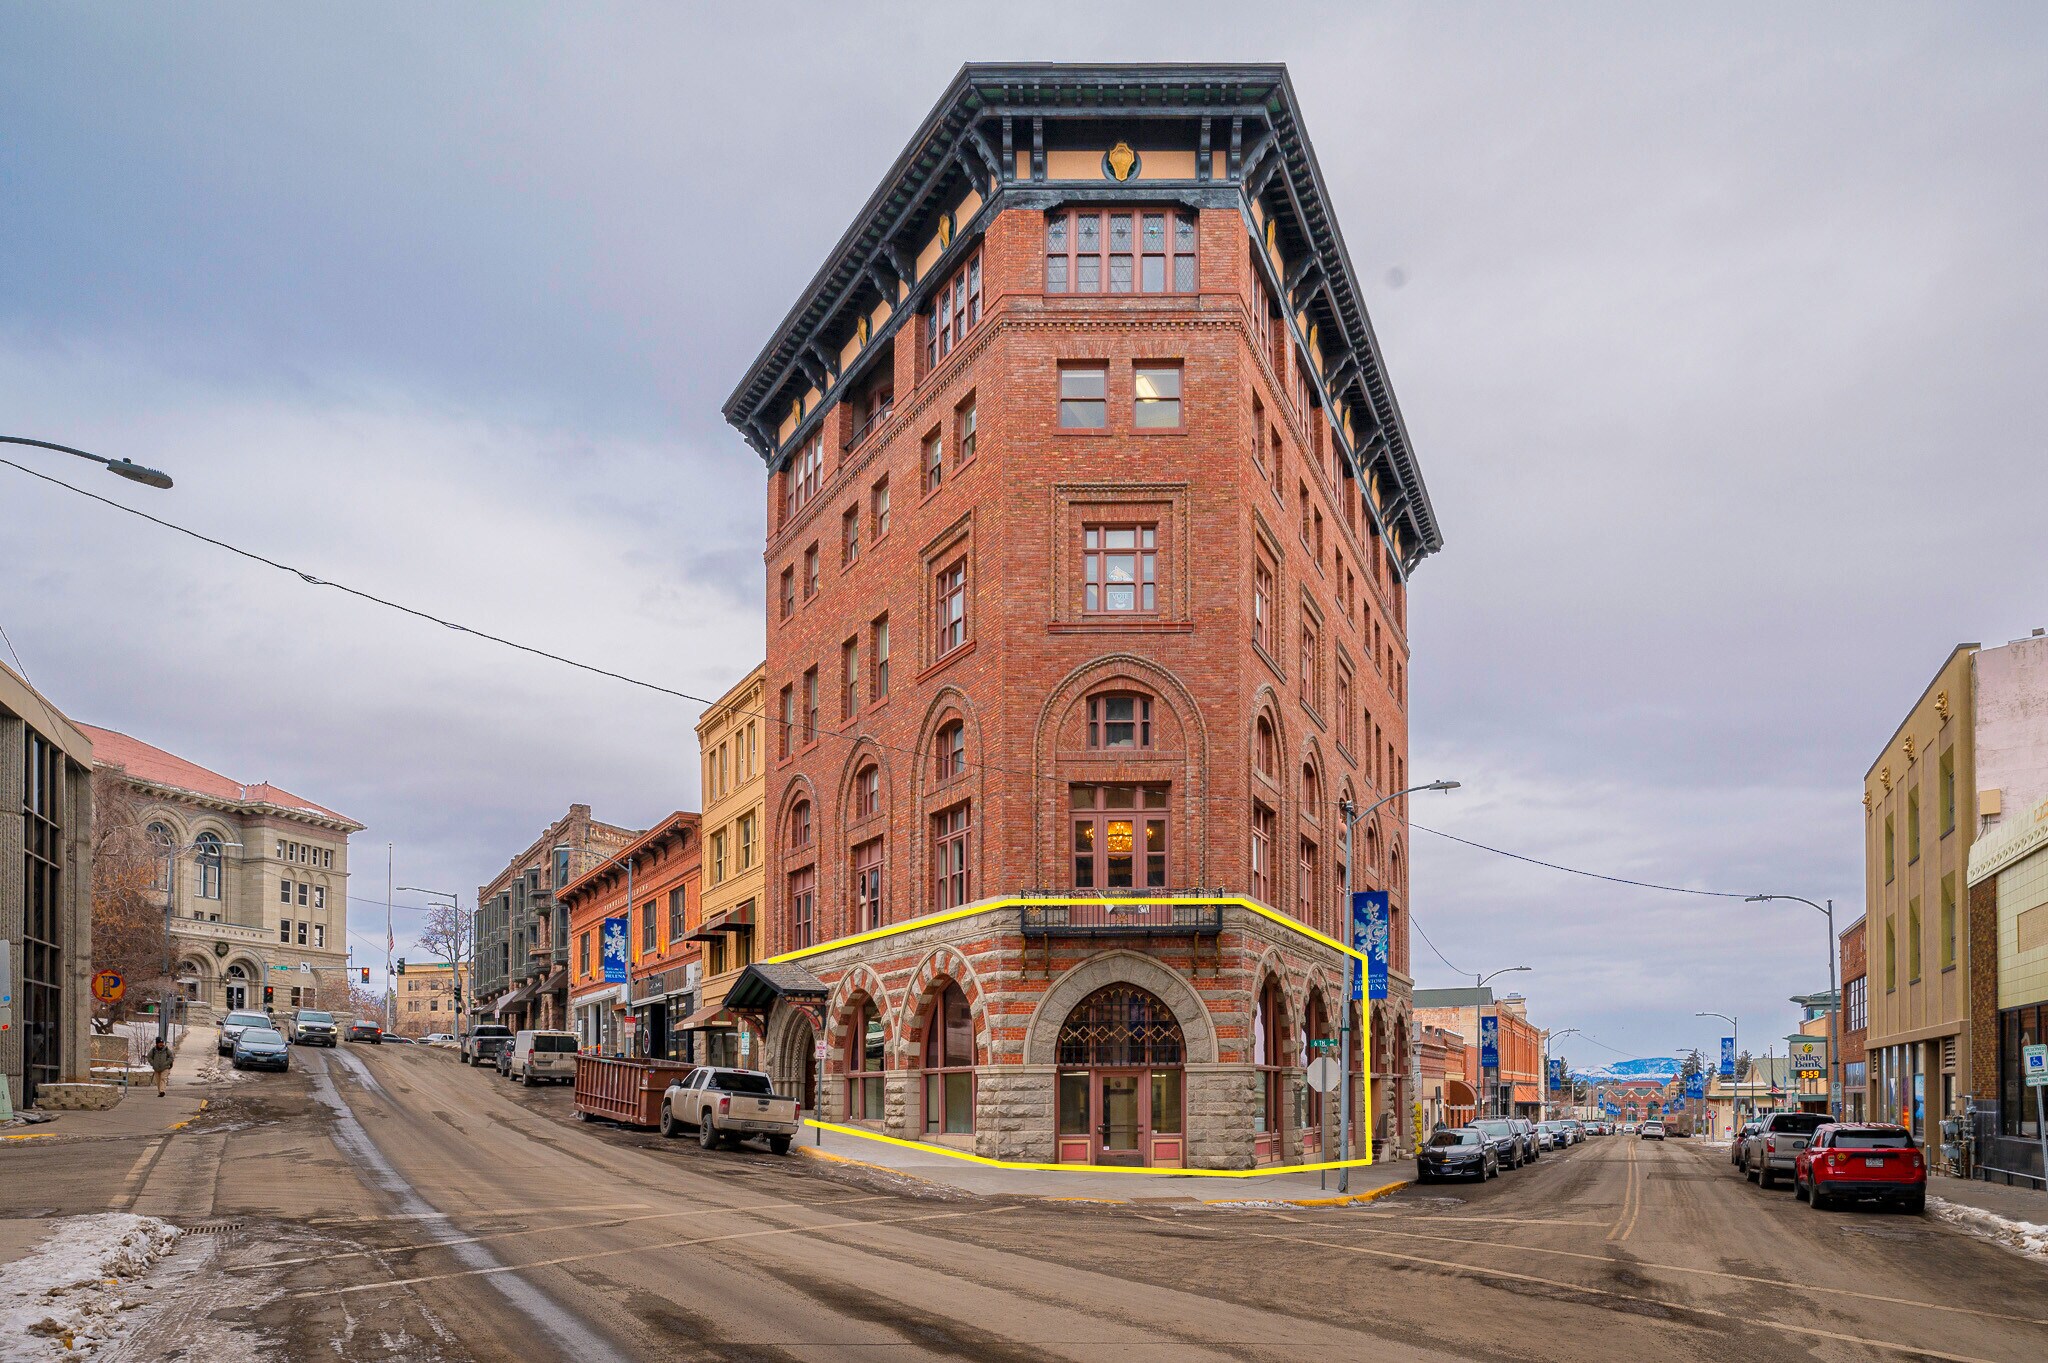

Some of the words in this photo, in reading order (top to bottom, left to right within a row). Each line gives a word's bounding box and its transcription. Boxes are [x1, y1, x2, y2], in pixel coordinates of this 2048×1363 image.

[101, 975, 121, 998] P
[1354, 984, 1387, 992] HENA
[1793, 1054, 1822, 1063] Valley
[1795, 1060, 1822, 1068] Bank
[1801, 1070, 1820, 1079] 9:59
